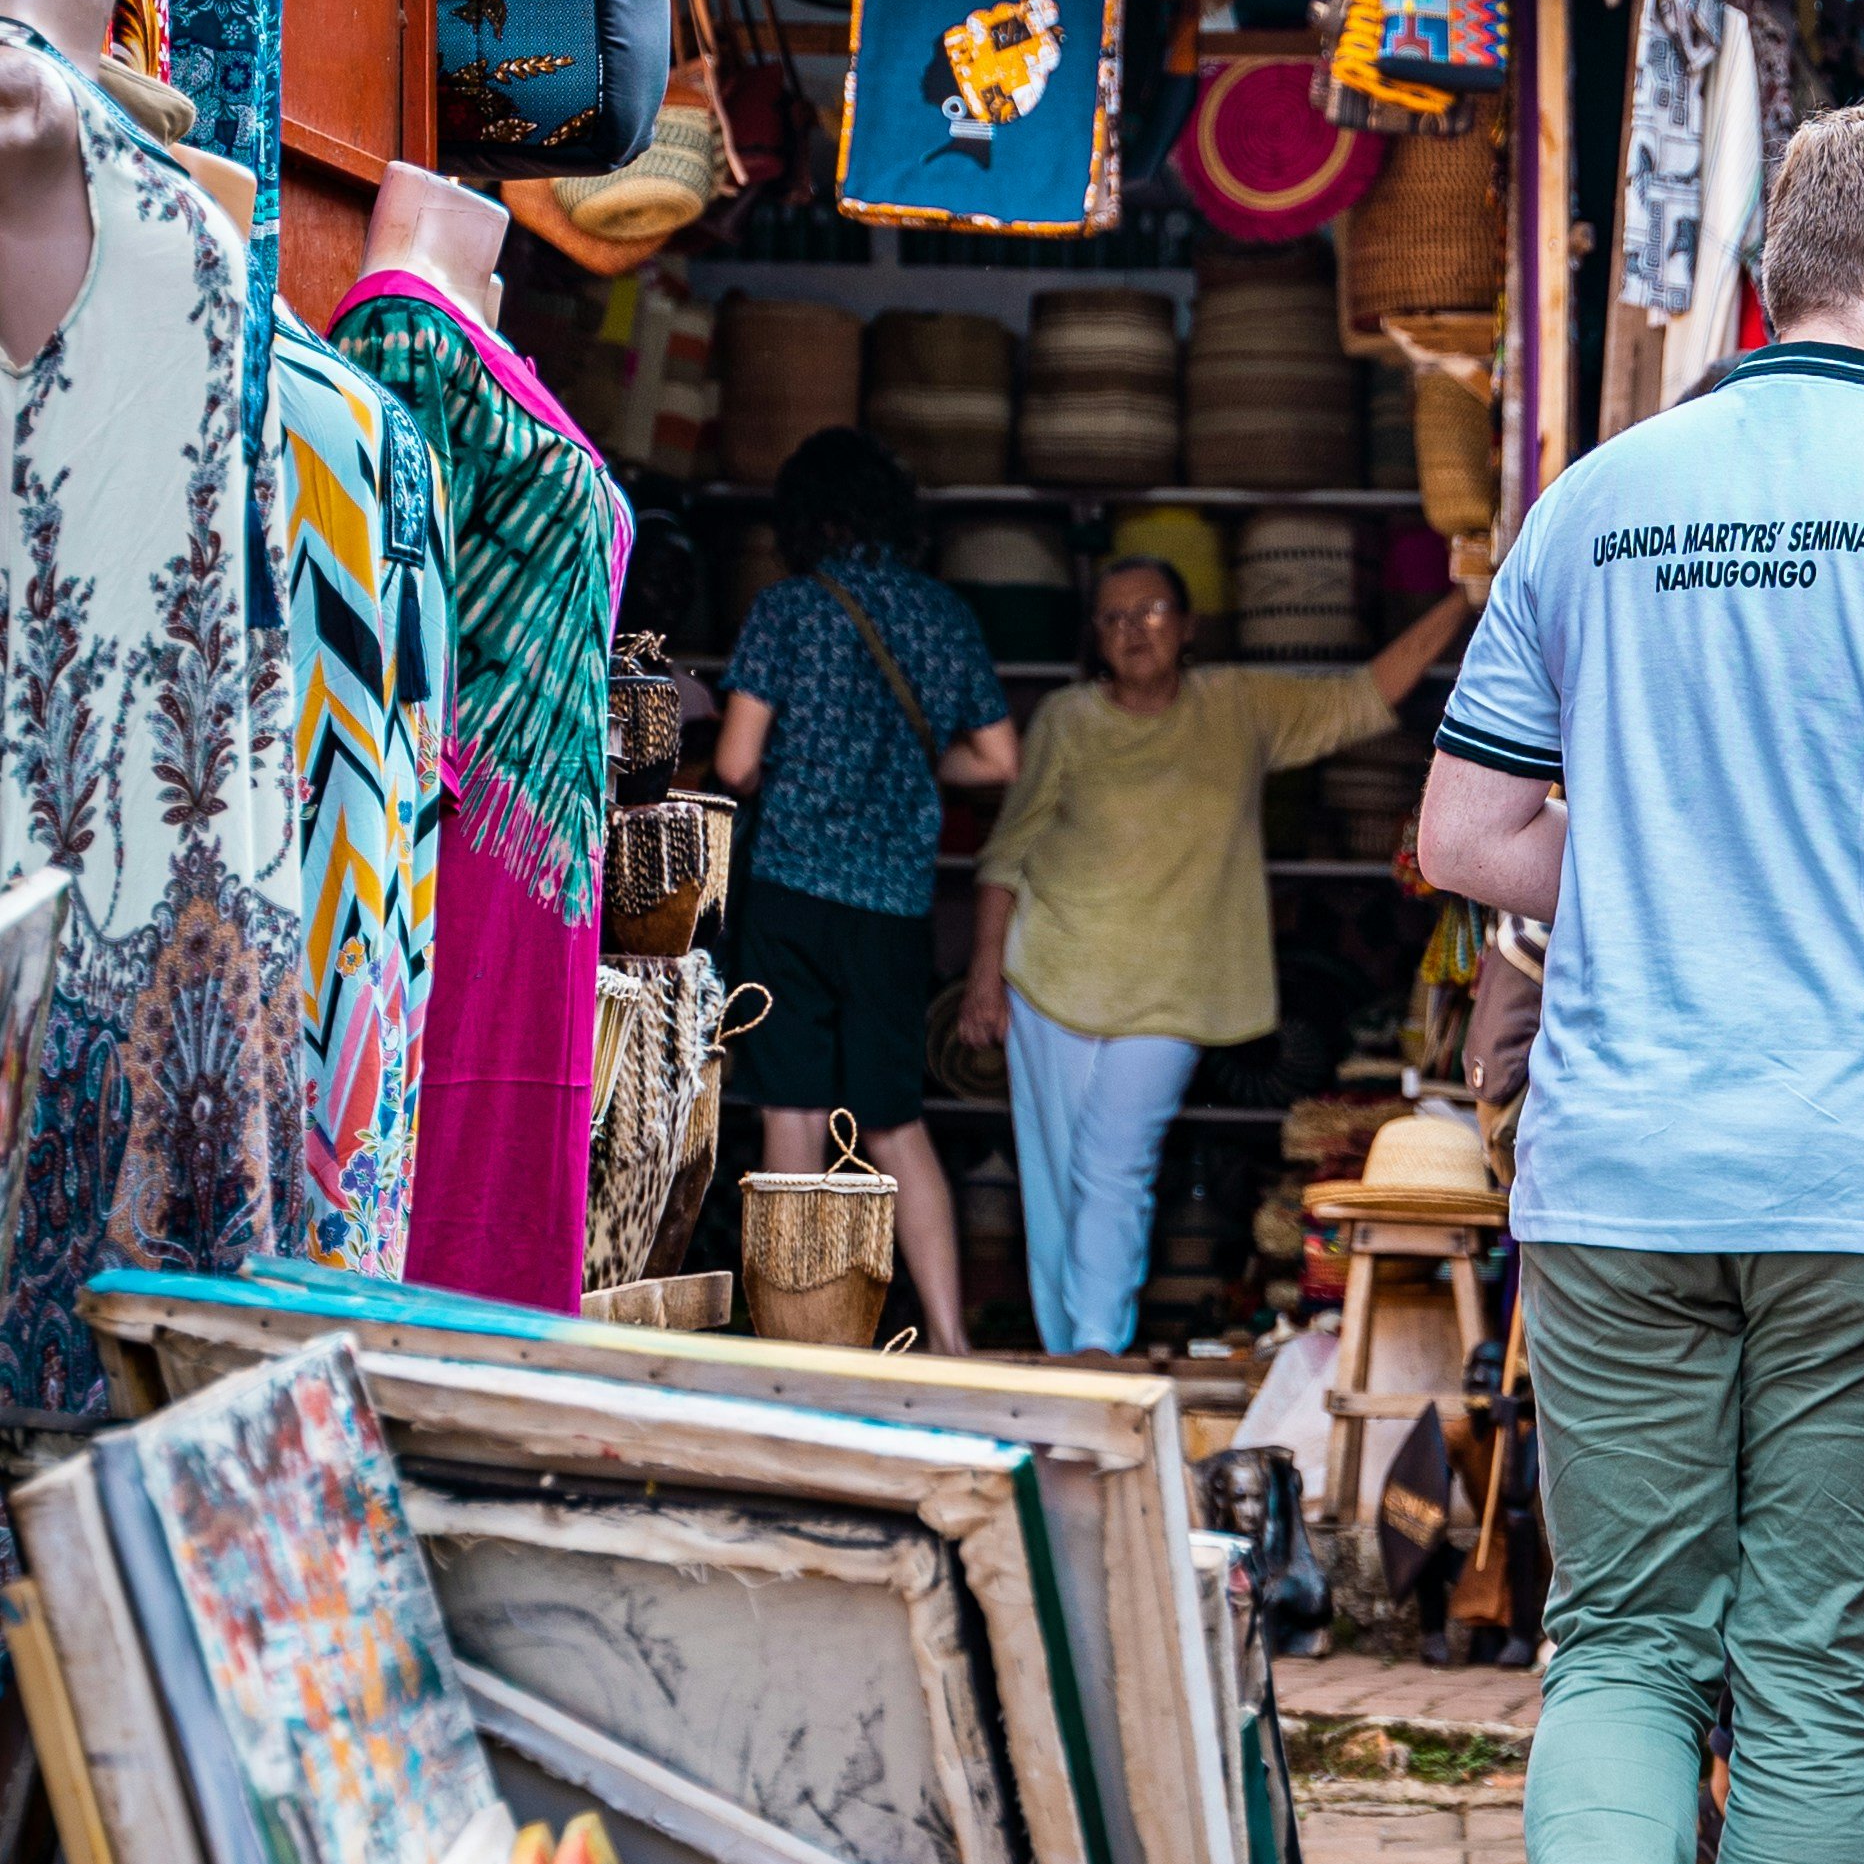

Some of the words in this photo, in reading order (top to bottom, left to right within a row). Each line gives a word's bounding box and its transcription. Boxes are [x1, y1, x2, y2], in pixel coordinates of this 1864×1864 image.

[1593, 524, 1677, 567] UGANDA
[1682, 521, 1786, 555] MARTYRS'
[1655, 559, 1817, 593] NAMUGONGO
